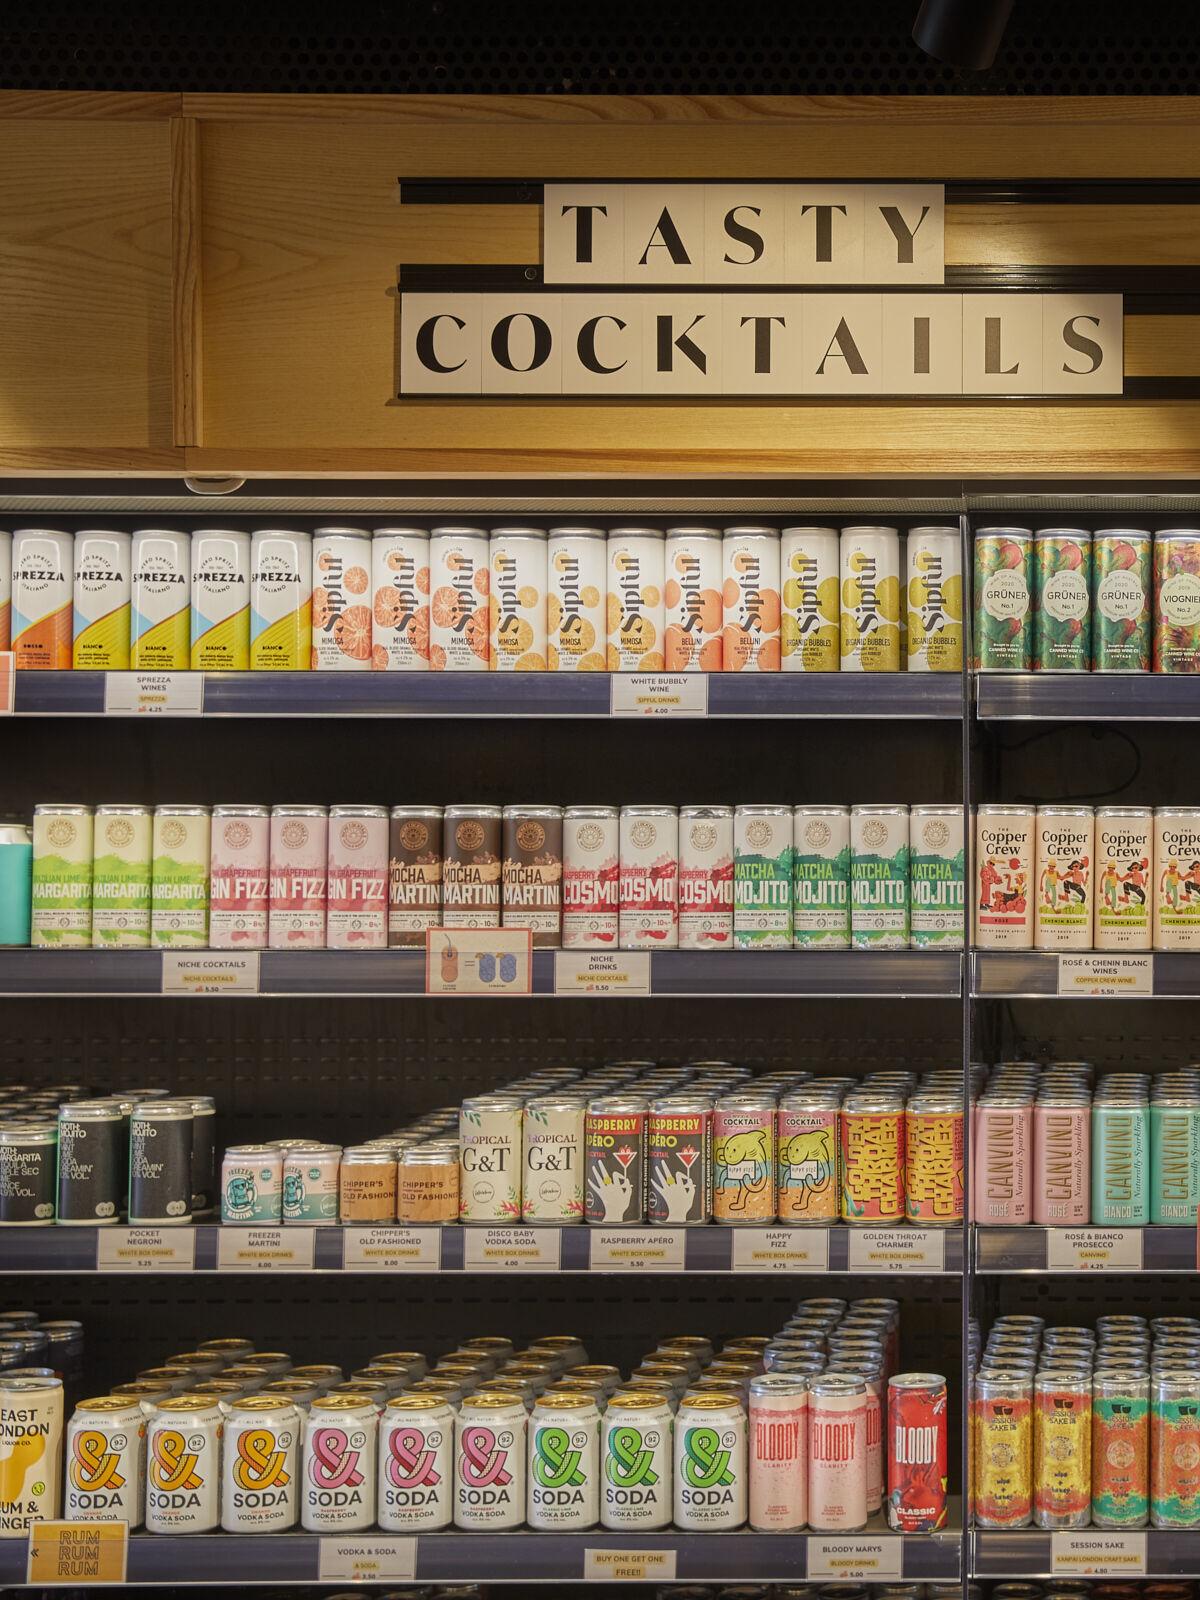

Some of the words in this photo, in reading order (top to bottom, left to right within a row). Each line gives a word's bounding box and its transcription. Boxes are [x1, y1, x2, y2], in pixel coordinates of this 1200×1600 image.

[561, 205, 931, 265] TASTY
[415, 313, 1104, 375] COCKTAILS
[987, 589, 1026, 599] GRÜNER
[981, 830, 1027, 844] Copper
[1042, 831, 1088, 844] Copper
[986, 844, 1021, 855] Crew
[1047, 845, 1082, 855] Crew
[329, 879, 348, 899] GIN
[352, 879, 384, 899] FIZZ
[504, 885, 559, 904] MARTINI
[564, 880, 618, 904] COSMO
[735, 881, 788, 904] MOJITO
[1063, 958, 1083, 966] ROSÉ
[723, 1118, 760, 1126] COCKTAIL
[463, 1136, 511, 1144] TROPICAL
[463, 1148, 510, 1172] G&T
[987, 1116, 1013, 1199] CANVINO
[1046, 1117, 1072, 1199] CANVINO
[757, 1422, 799, 1460] BLOODY
[70, 1493, 123, 1509] SODA
[150, 1493, 201, 1509] SODA
[60, 1531, 100, 1544] RUM
[59, 1546, 100, 1560] RUM
[58, 1562, 98, 1575] RUM
